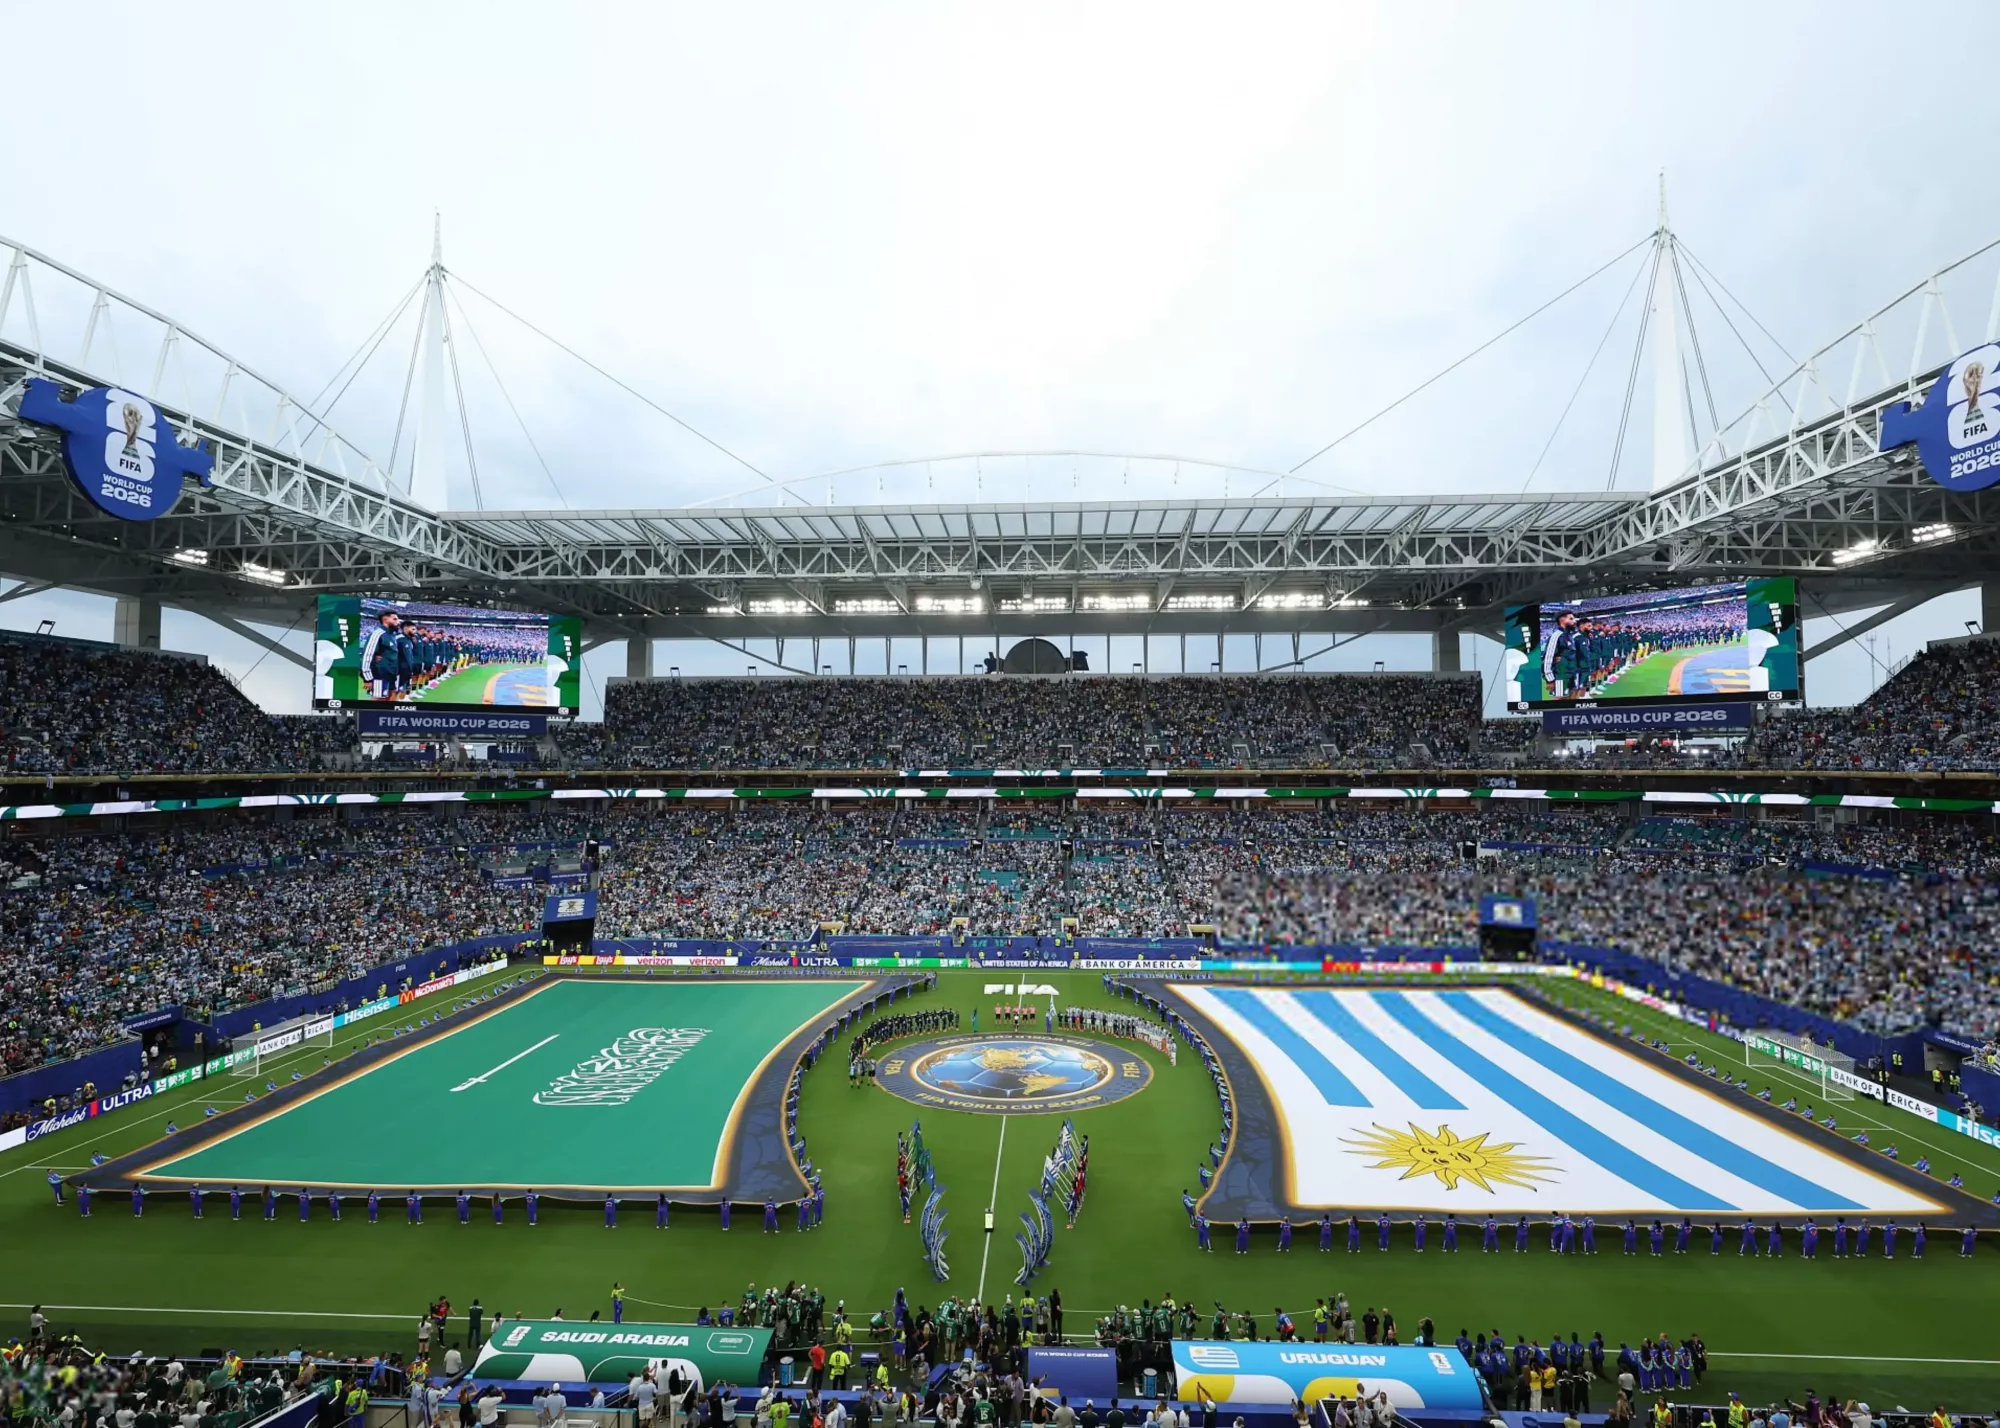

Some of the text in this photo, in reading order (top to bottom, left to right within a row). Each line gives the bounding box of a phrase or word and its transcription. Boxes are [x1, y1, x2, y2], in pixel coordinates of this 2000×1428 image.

[1963, 422, 1988, 438] FIFA
[1950, 447, 1983, 464] WORLD
[119, 458, 142, 473] FIFA
[1950, 451, 2000, 478] 2026
[103, 474, 152, 494] WORLD CUP
[101, 484, 152, 508] 2026
[378, 717, 530, 730] FIFA WORLD CUP 2026
[1561, 710, 1728, 726] FIFA WORLD CUP 2026
[637, 956, 674, 966] verizon
[690, 957, 726, 966] verizon
[750, 956, 840, 966] Michelob ULTRA
[1086, 960, 1184, 969] BANK OF AMERICA
[414, 976, 453, 998] McDonald's
[984, 984, 1060, 996] FIFA
[344, 1000, 390, 1025] Hisense
[280, 1036, 292, 1045] OF
[1121, 1062, 1140, 1078] FIFA
[1834, 1071, 1921, 1112] BANK OF AERICA
[916, 1092, 945, 1103] FIFA
[948, 1100, 1007, 1110] WORLD
[27, 1084, 152, 1141] Michelob ULTRA
[540, 1331, 690, 1347] SAUDI ARABIA
[1280, 1352, 1386, 1366] URUGUAY
